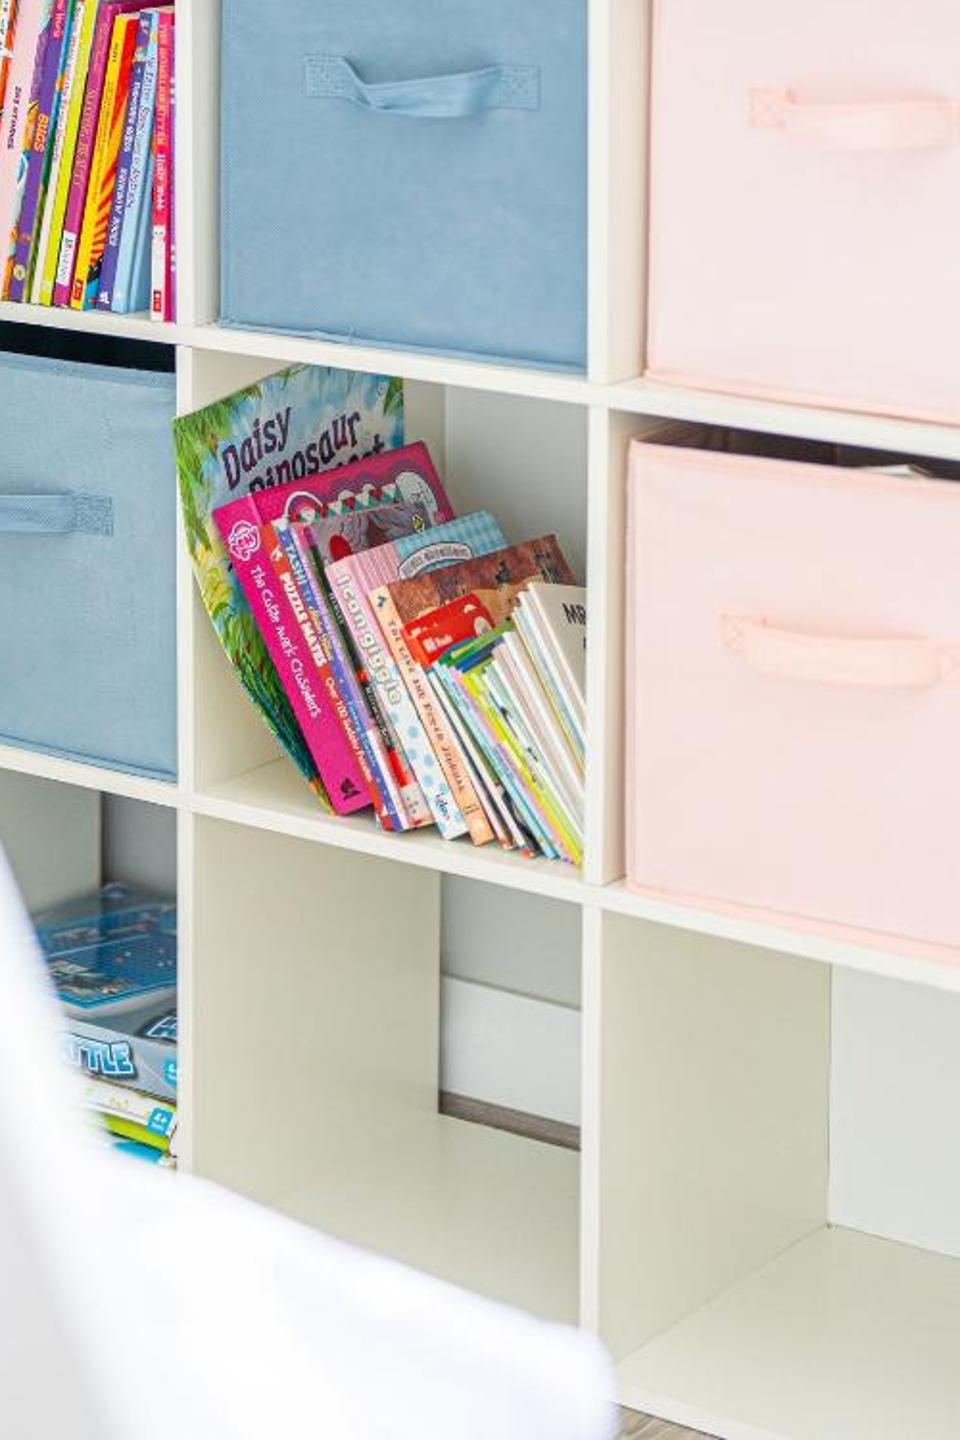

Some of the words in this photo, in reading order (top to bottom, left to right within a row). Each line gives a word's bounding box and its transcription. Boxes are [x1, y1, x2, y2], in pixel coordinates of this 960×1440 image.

[33, 111, 50, 154] BUGS
[222, 407, 292, 490] Daisy
[249, 563, 270, 588] The
[283, 543, 307, 585] TASHI
[259, 586, 284, 623] Cutie
[278, 570, 309, 622] PUZZLE
[299, 620, 328, 668] MATES
[340, 584, 371, 630] can
[356, 629, 406, 708] giggle
[287, 655, 324, 719] Crusaders
